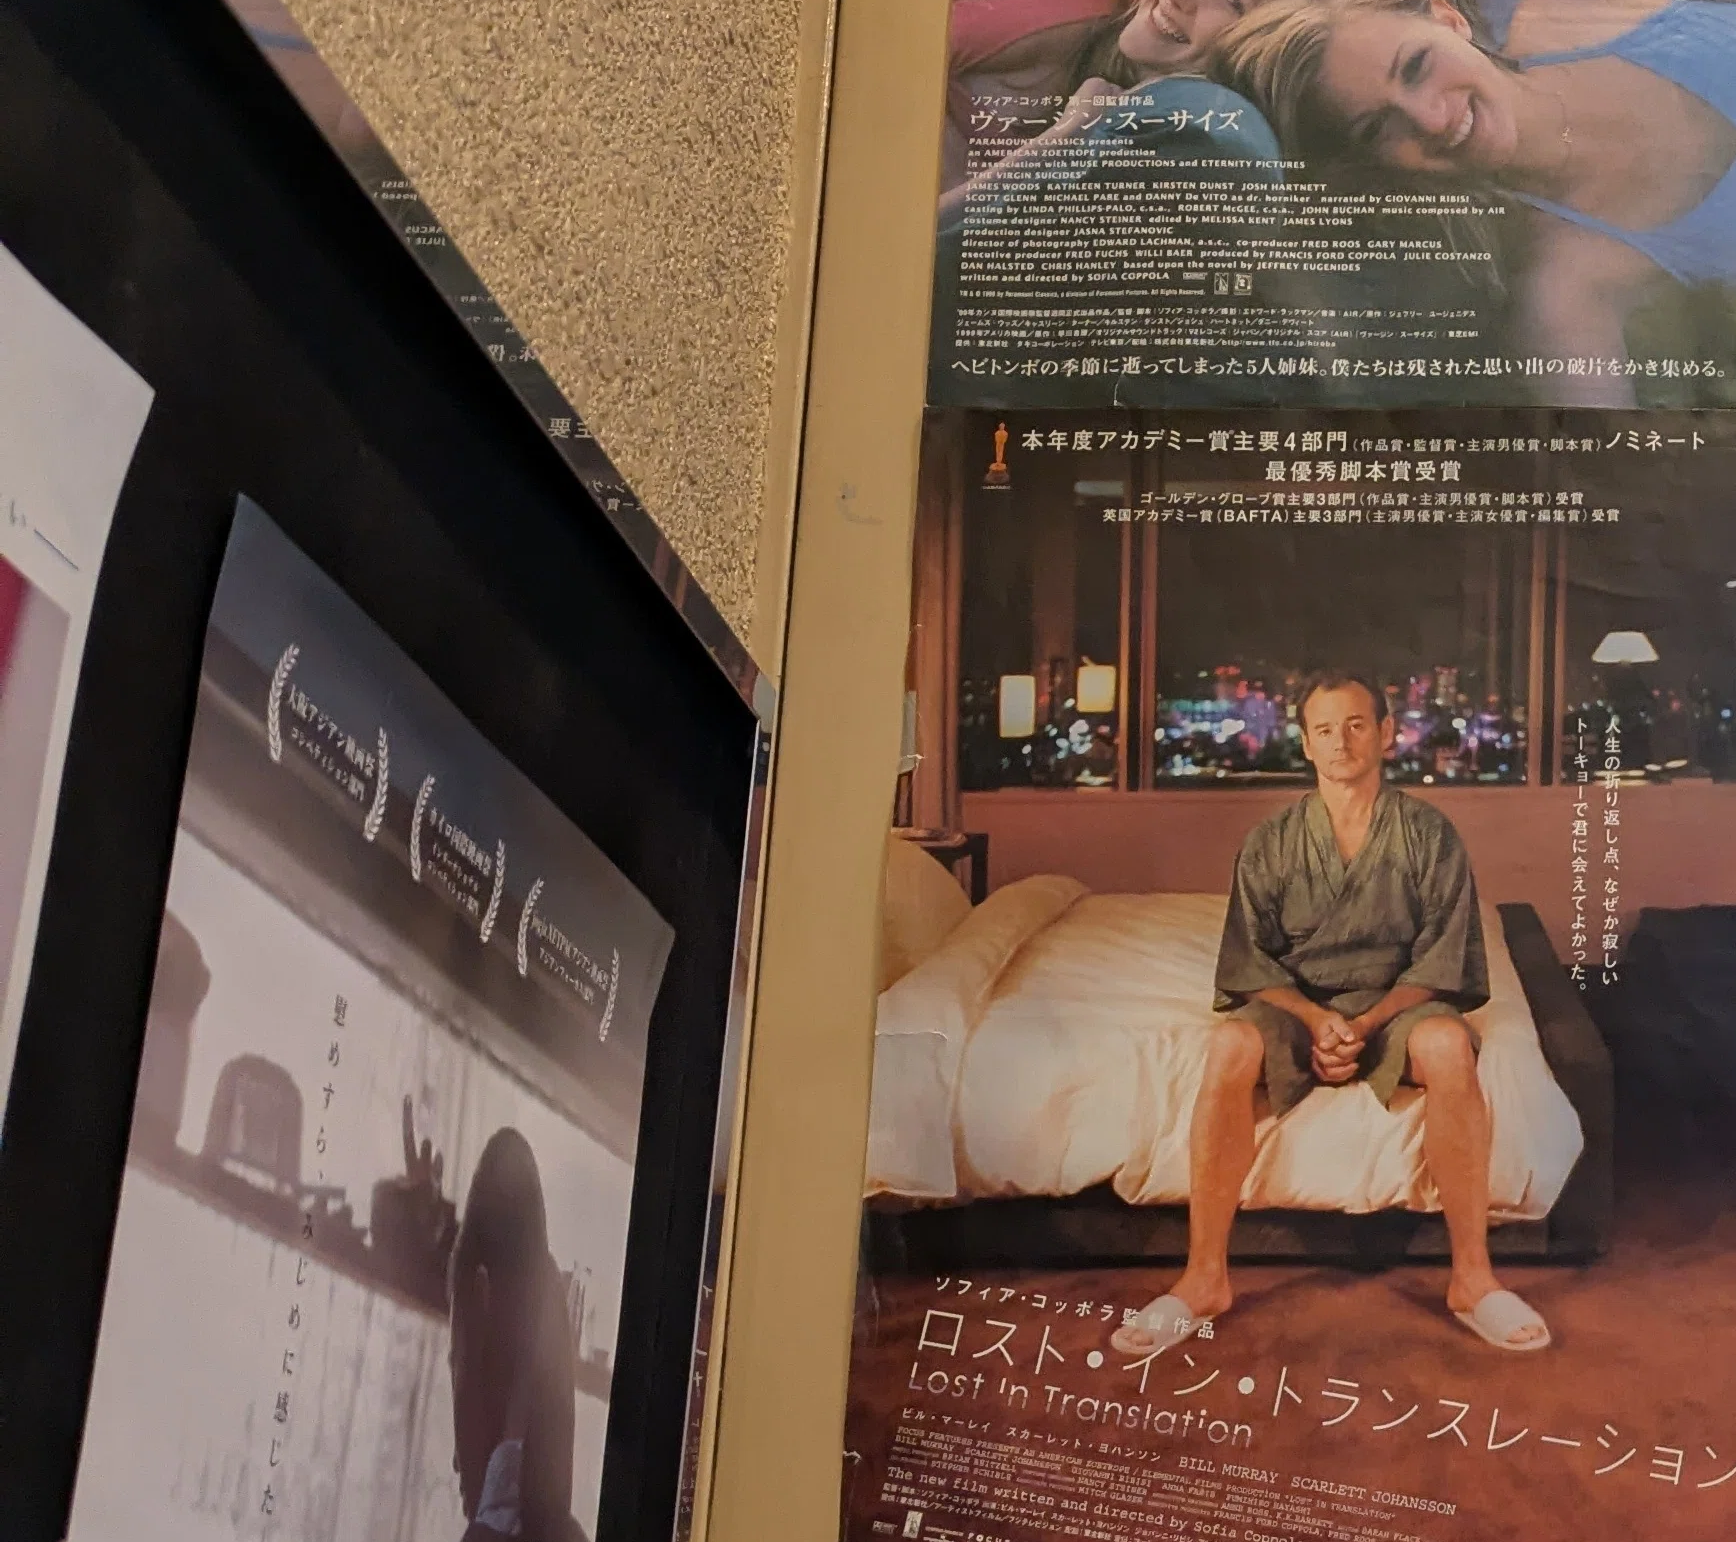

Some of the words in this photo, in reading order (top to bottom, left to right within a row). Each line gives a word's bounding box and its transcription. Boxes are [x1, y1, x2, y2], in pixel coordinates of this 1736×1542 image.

[970, 109, 1244, 132] ヴァージン・スーサイズ
[968, 149, 981, 158] an
[984, 148, 1038, 158] AMERICAN
[1041, 148, 1097, 158] ZOETROPE
[1099, 148, 1156, 159] production
[969, 137, 1036, 147] PARAMOUNT
[1037, 137, 1085, 147] CLASSICS
[1088, 137, 1134, 148] presents
[966, 182, 999, 192] JAMES
[1001, 182, 1040, 192] WOODS
[1047, 182, 1101, 192] KATHLEEN
[1104, 182, 1146, 192] TURNER
[1152, 182, 1196, 192] KIRSTEN
[1199, 182, 1235, 192] DUNST
[1241, 182, 1268, 192] JOSH
[1271, 182, 1327, 192] HARTNETT
[960, 273, 998, 283] written
[1001, 273, 1021, 283] and
[1024, 272, 1068, 282] directed
[1071, 272, 1084, 284] by
[1087, 272, 1118, 282] SOFIA
[1120, 272, 1170, 282] COPPOLA
[1265, 459, 1462, 483] 最優秀脚本賞受賞
[908, 1361, 985, 1400] Lost
[1043, 1384, 1254, 1449] Translation
[1178, 1456, 1217, 1474] BILL
[1221, 1463, 1280, 1485] MURRAY
[1291, 1476, 1367, 1500] SCARLETT
[1371, 1490, 1457, 1516] JOHANSSON
[887, 1466, 913, 1481] The
[918, 1474, 947, 1487] new
[951, 1478, 988, 1494] film
[993, 1485, 1055, 1507] written
[1060, 1497, 1088, 1512] and
[1093, 1501, 1164, 1526] directed
[1169, 1515, 1188, 1532] by
[1193, 1520, 1238, 1539] Sofia
